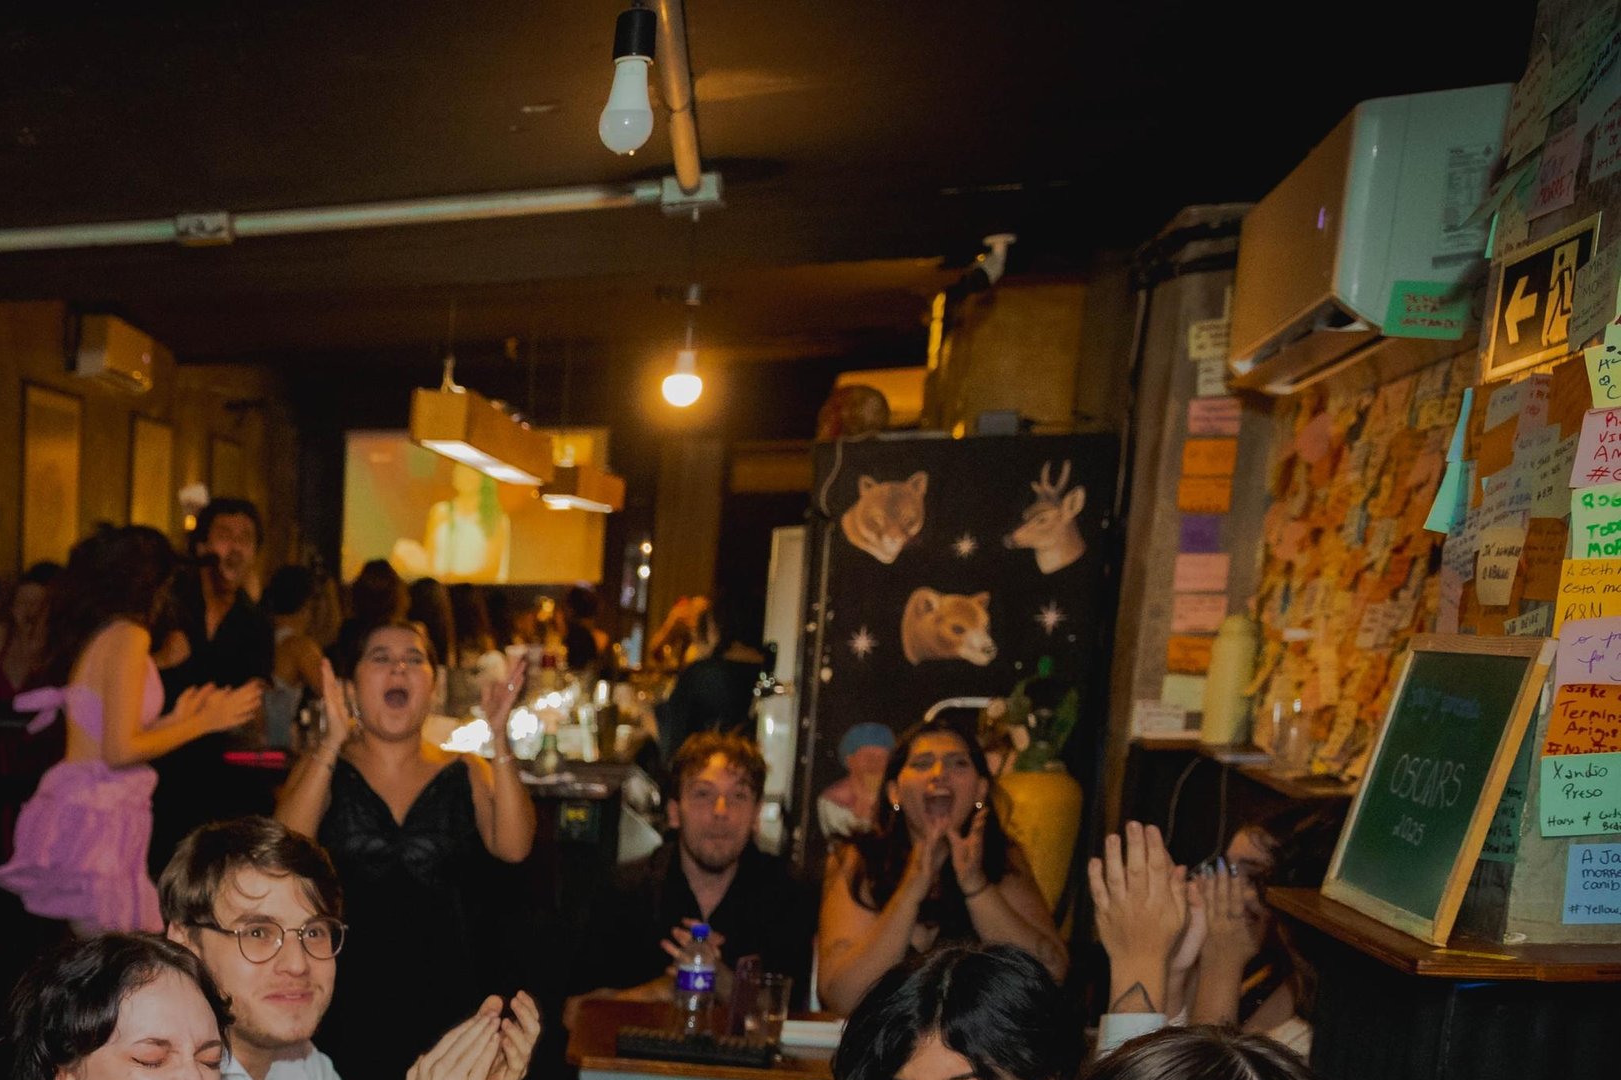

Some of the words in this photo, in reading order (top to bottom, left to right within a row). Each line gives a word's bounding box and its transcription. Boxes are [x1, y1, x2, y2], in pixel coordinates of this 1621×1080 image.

[1390, 753, 1466, 809] OSCARS
[1562, 782, 1603, 799] Preso
[1392, 814, 1427, 847] 2025
[1582, 849, 1593, 864] A
